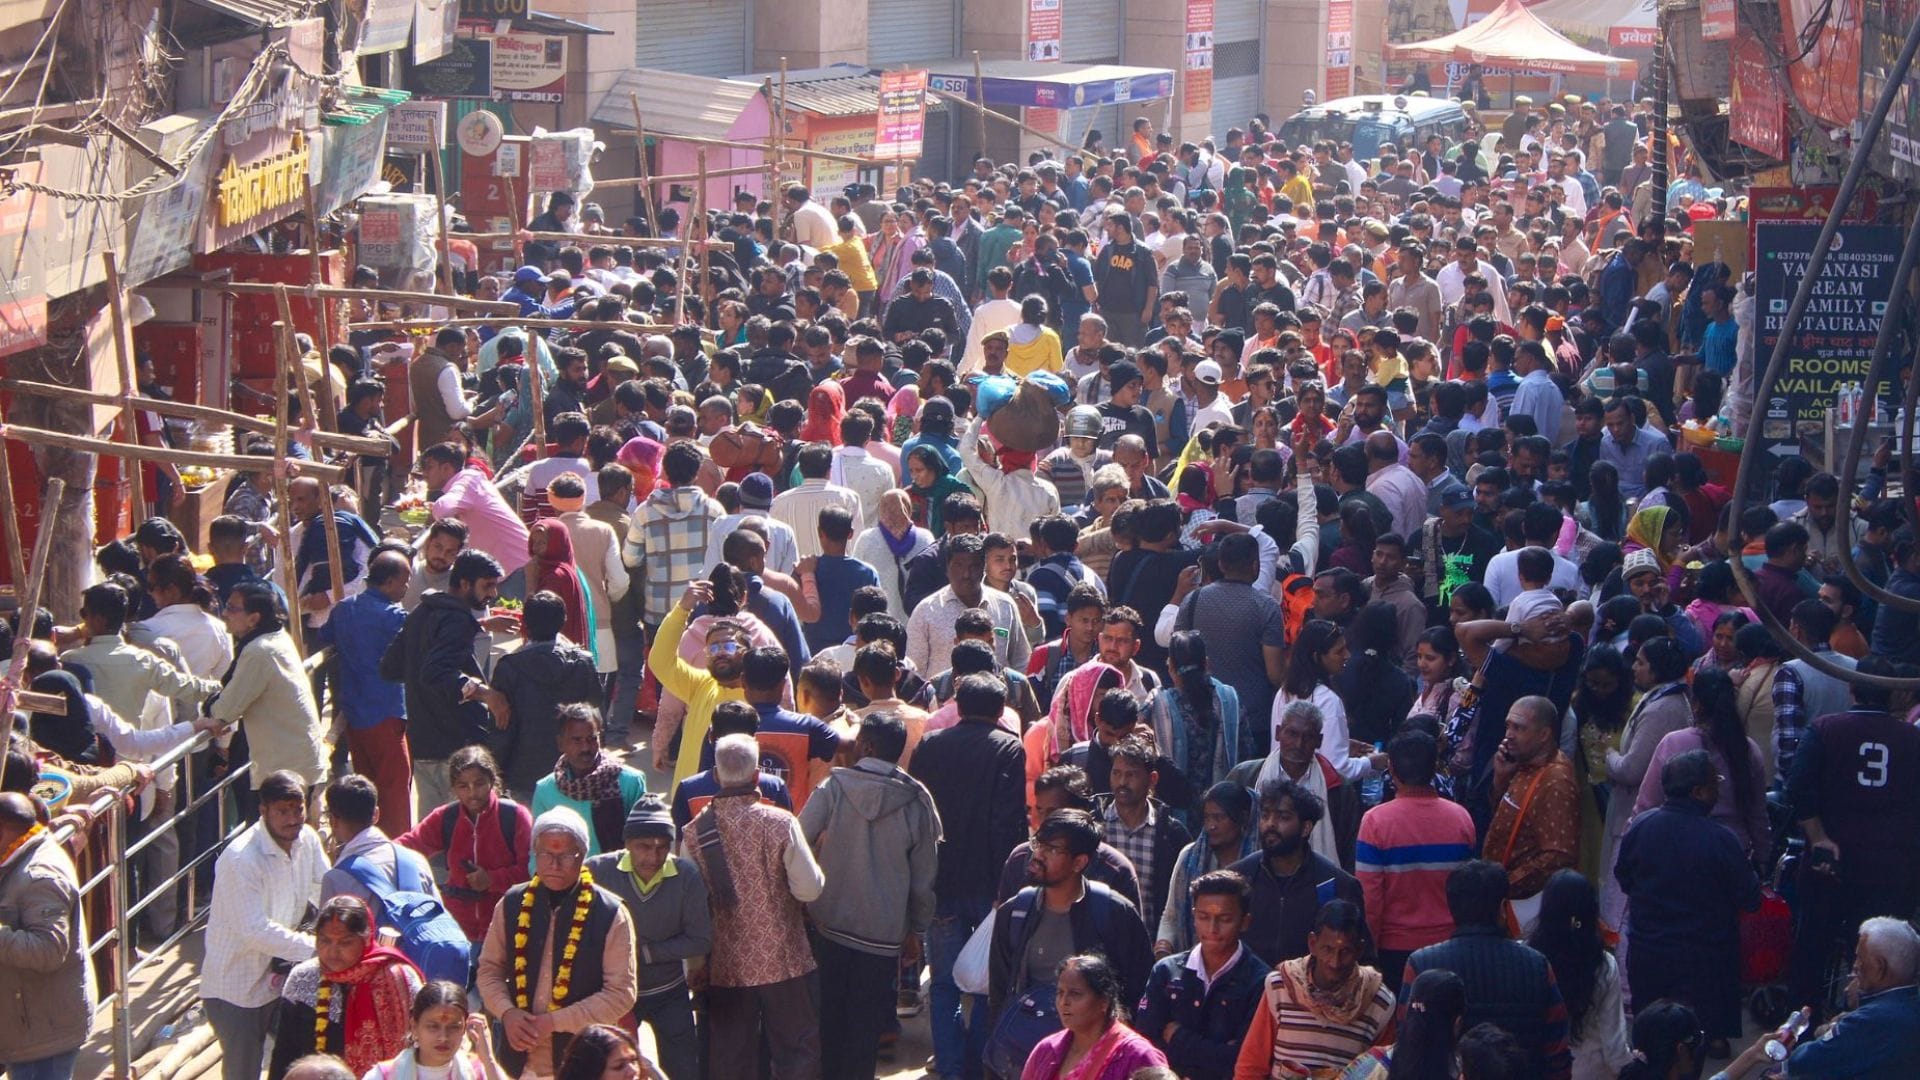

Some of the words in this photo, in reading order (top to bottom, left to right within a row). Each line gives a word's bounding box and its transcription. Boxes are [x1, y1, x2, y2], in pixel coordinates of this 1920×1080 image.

[945, 80, 967, 93] SBI
[487, 184, 499, 200] 2
[1782, 262, 1879, 278] VAANASI
[1797, 281, 1865, 296] REAM
[1804, 299, 1867, 314] AMILY
[1790, 358, 1872, 376] ROOMS
[1774, 378, 1891, 396] VAILAE
[1811, 398, 1833, 408] AC
[1858, 741, 1889, 787] 3
